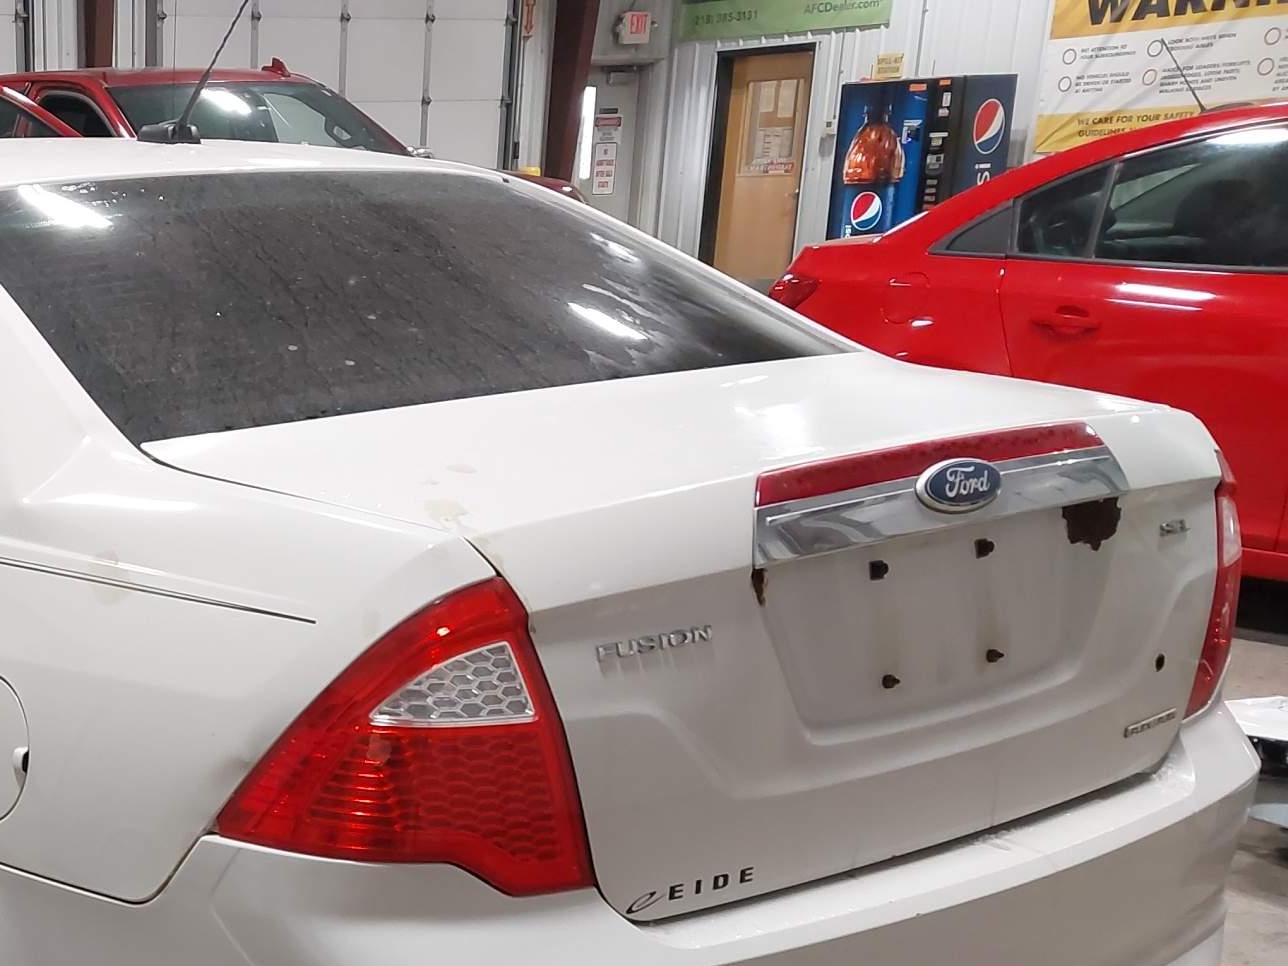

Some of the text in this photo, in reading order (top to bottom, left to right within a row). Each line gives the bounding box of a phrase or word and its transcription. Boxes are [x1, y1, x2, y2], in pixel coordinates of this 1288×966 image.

[630, 13, 649, 34] EXIT
[1092, 116, 1113, 125] CARE
[1116, 115, 1133, 124] FOR
[1136, 113, 1161, 122] YOUR
[945, 465, 990, 498] Ford
[597, 624, 713, 663] FUSION
